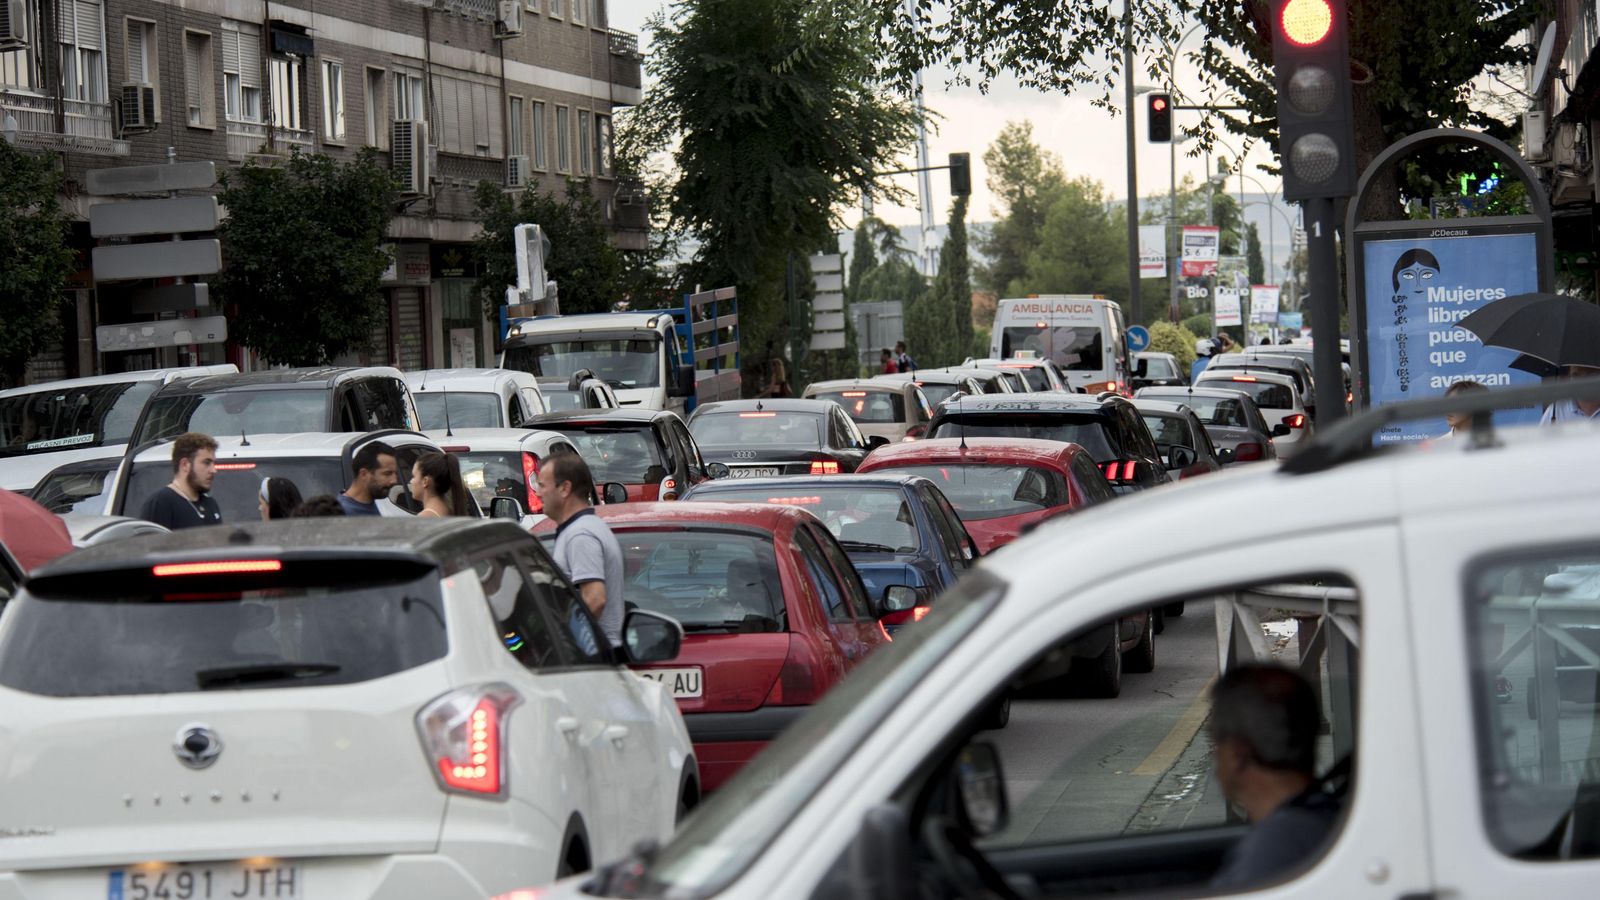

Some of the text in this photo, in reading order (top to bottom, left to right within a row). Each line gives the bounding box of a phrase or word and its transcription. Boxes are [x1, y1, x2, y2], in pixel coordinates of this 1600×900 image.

[1430, 229, 1468, 237] JCDecaux
[1187, 285, 1209, 298] Bio
[1427, 286, 1506, 305] Mujeres
[1012, 304, 1093, 313] AMBULANCIA
[1428, 307, 1477, 323] libre
[1429, 329, 1478, 347] pueb
[1429, 350, 1467, 367] que
[727, 469, 751, 478] 422
[674, 672, 699, 693] AU
[131, 867, 296, 900] 5491 JTH
